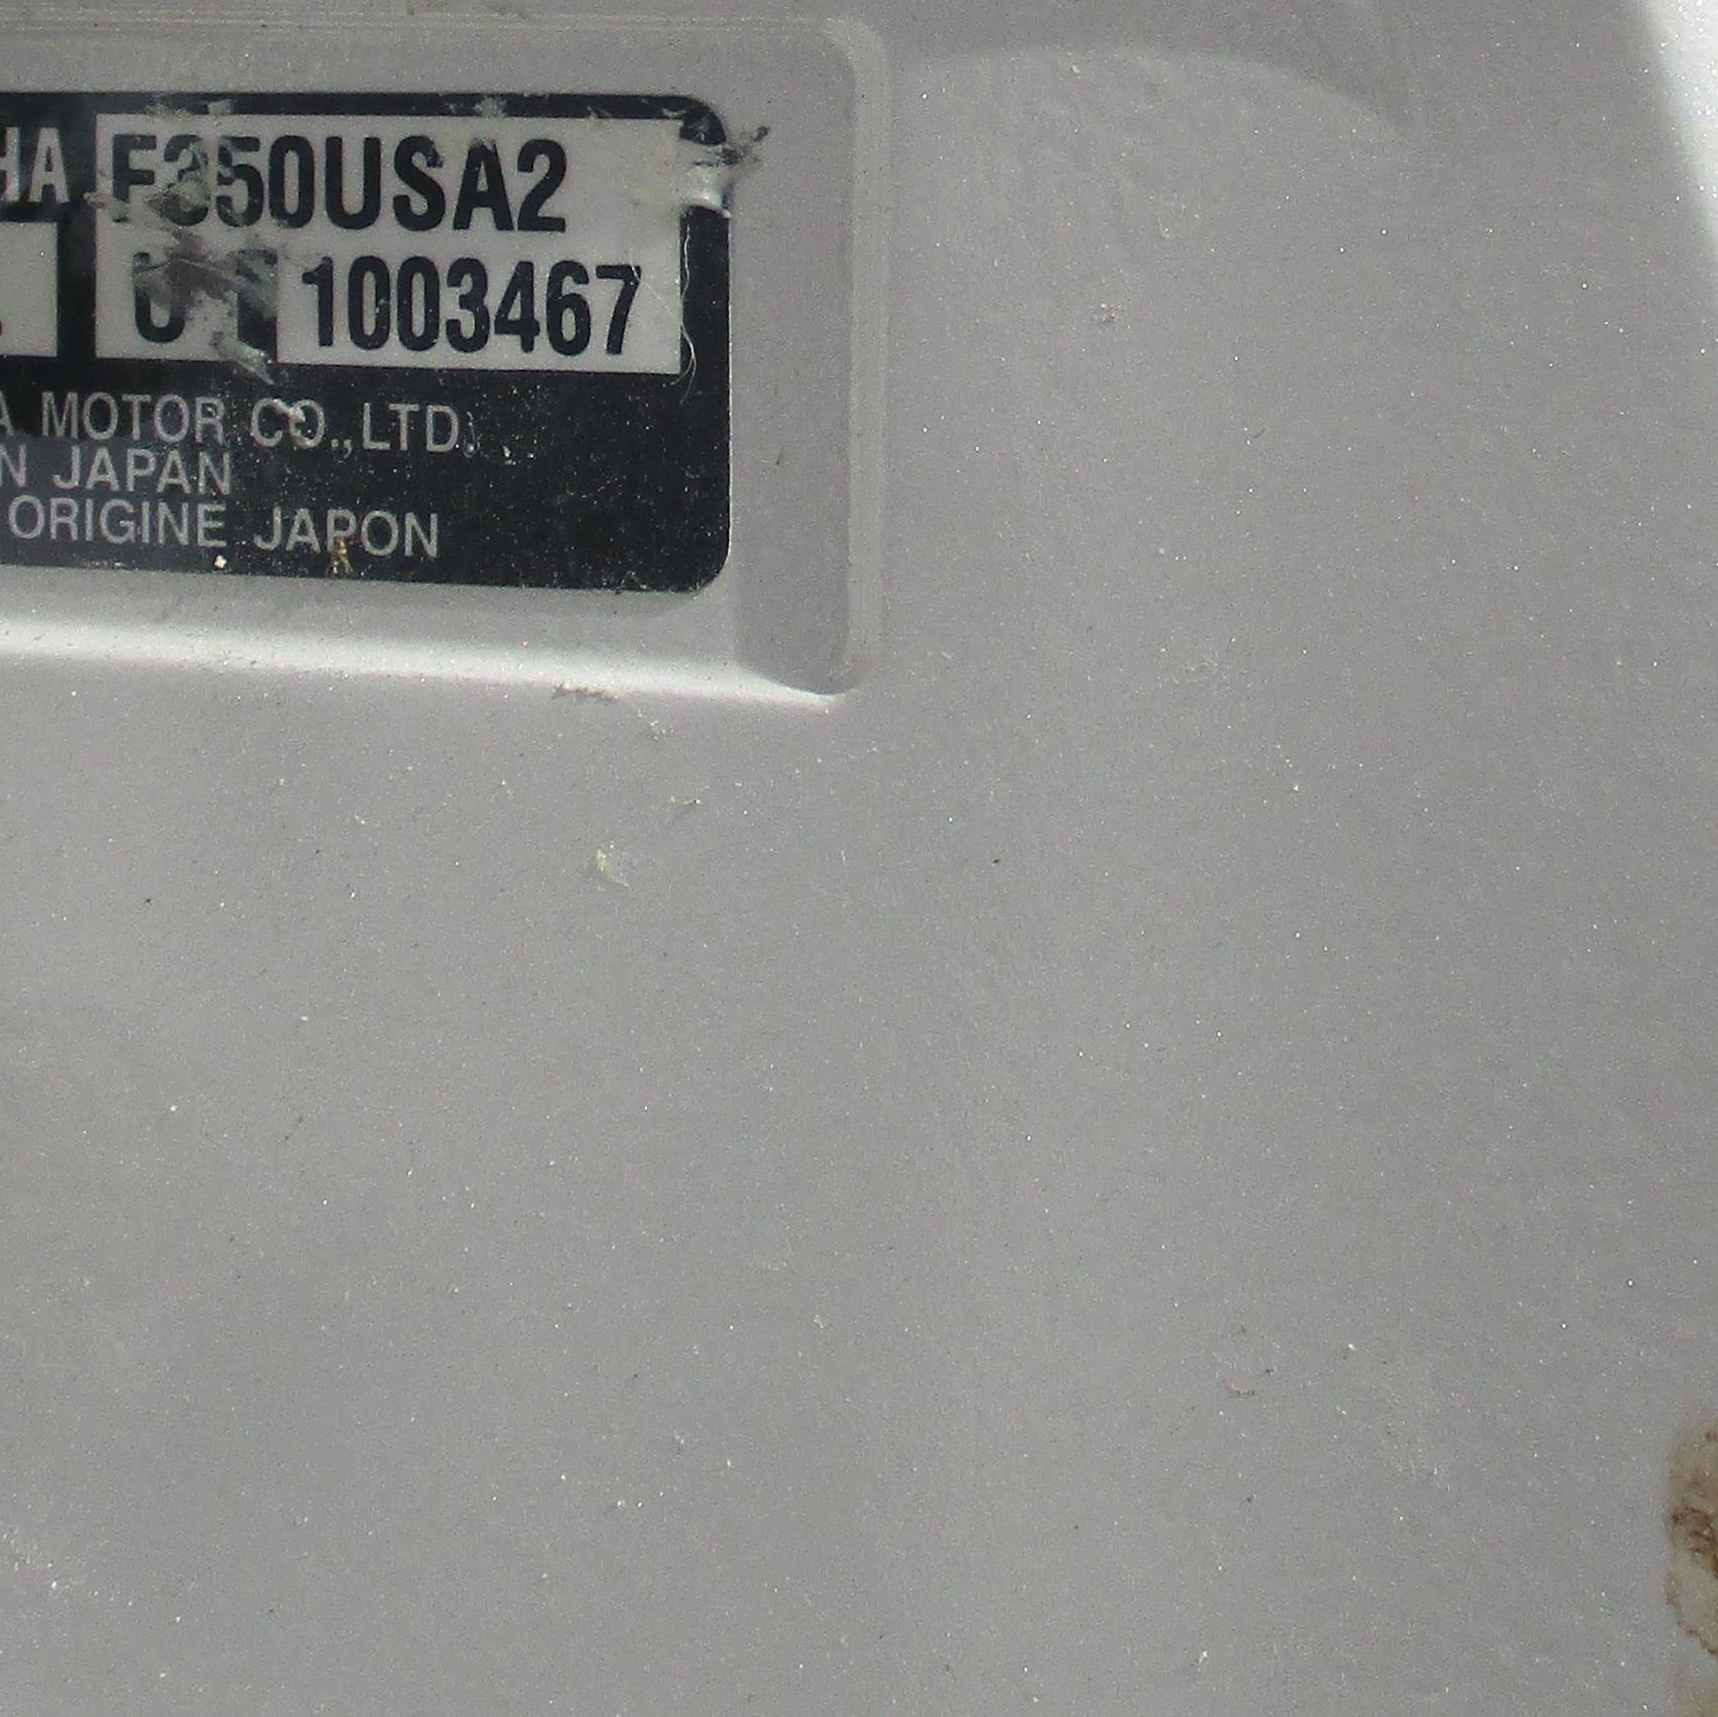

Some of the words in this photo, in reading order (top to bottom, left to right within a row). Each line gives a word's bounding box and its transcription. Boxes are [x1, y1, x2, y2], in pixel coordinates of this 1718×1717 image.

[302, 255, 641, 356] 1003467
[41, 390, 225, 445] MOTOR
[52, 445, 231, 496] JAPAN
[253, 507, 440, 559] JAPON
